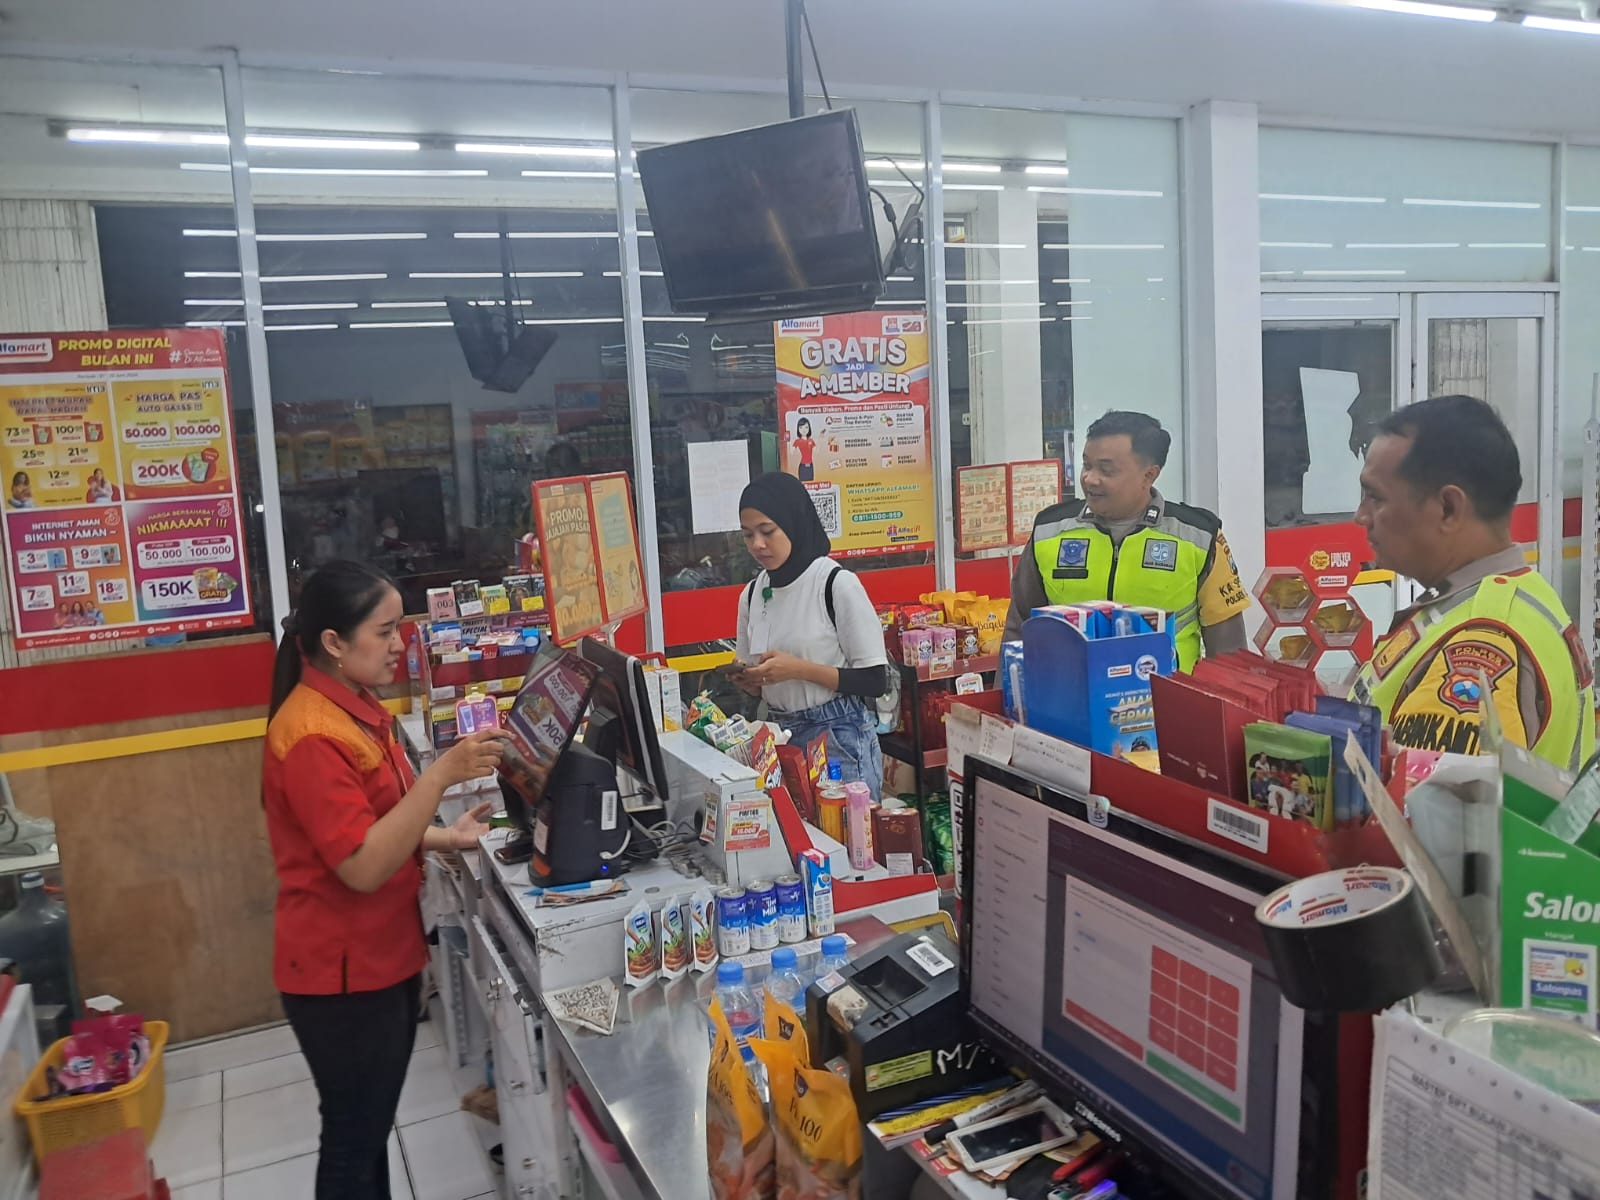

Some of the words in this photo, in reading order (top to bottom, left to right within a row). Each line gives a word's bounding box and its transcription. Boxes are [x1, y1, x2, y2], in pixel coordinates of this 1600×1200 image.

[781, 319, 820, 329] Alfamart
[0, 341, 46, 352] lfamart
[58, 338, 113, 352] PROMO
[116, 336, 172, 350] DIGITAL
[800, 337, 907, 368] GRATIS
[81, 354, 133, 368] BULAN
[134, 353, 154, 366] INI
[845, 363, 865, 371] JADI
[136, 393, 176, 402] HARGA
[180, 391, 201, 400] PAS
[5, 427, 20, 437] 73
[55, 425, 74, 435] 100
[125, 427, 167, 438] 50.000
[174, 425, 221, 436] 100.000
[22, 450, 36, 459] 25
[68, 448, 79, 457] 21
[48, 470, 60, 480] 12
[138, 464, 180, 478] 200K
[550, 508, 583, 526] PROMO
[32, 520, 74, 531] INTERNET
[76, 518, 101, 527] AMAN
[137, 517, 212, 535] NIKMAAAAT
[24, 532, 56, 544] BIKIN
[59, 528, 107, 540] NYAMAN
[26, 552, 36, 564] 3
[80, 548, 89, 560] 9
[145, 549, 182, 560] 50.000
[190, 546, 231, 557] 100.000
[61, 575, 75, 587] 11
[27, 589, 36, 601] 7
[98, 582, 114, 594] 18
[149, 581, 193, 598] 150K
[200, 590, 227, 599] GRATIS
[1219, 582, 1234, 597] KA
[437, 599, 454, 609] 003
[1300, 903, 1348, 924] Alfamart
